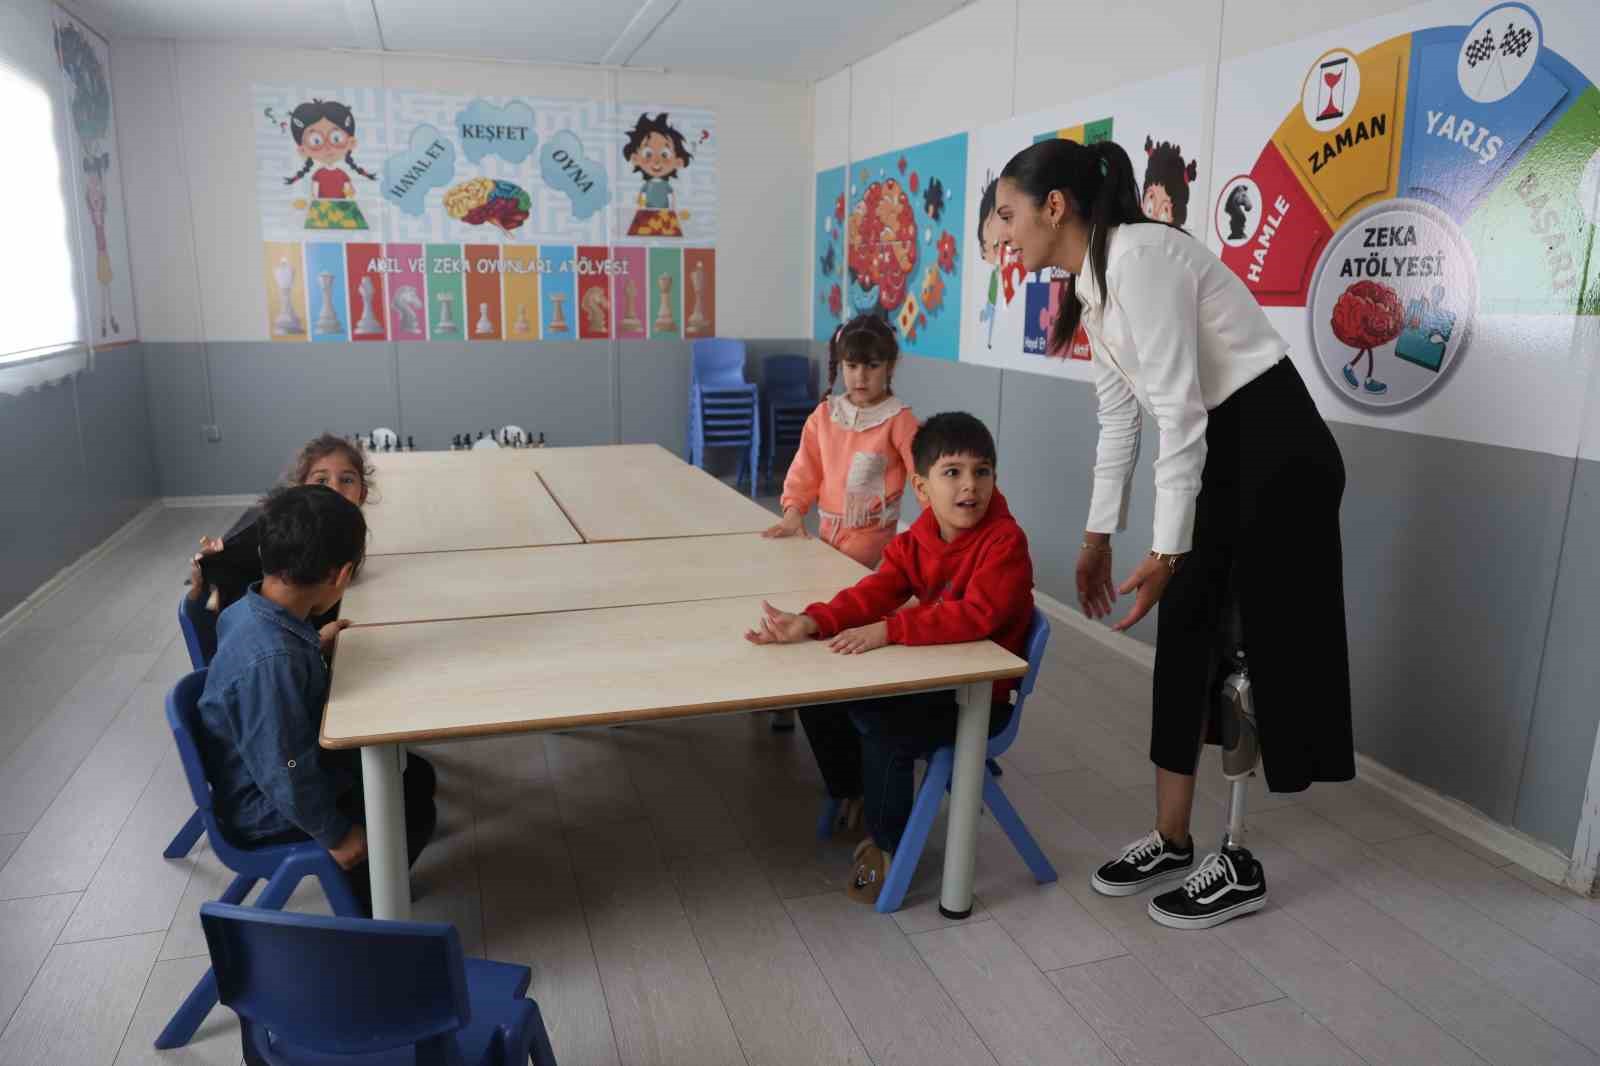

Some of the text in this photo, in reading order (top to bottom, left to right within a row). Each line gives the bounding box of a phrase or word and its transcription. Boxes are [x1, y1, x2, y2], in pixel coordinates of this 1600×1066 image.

[461, 123, 529, 143] KEŞFET
[1307, 113, 1387, 175] ZAMAN
[1425, 110, 1504, 164] YARIŞ
[551, 149, 595, 193] OYNA
[1247, 194, 1290, 282] HAMLE
[1363, 225, 1418, 248] ZEKA
[367, 259, 402, 274] AKIL
[407, 259, 426, 273] VE
[433, 258, 470, 273] ZEKA
[476, 258, 552, 273] OYUNLARI
[1340, 251, 1446, 277] ATÖLYESİ
